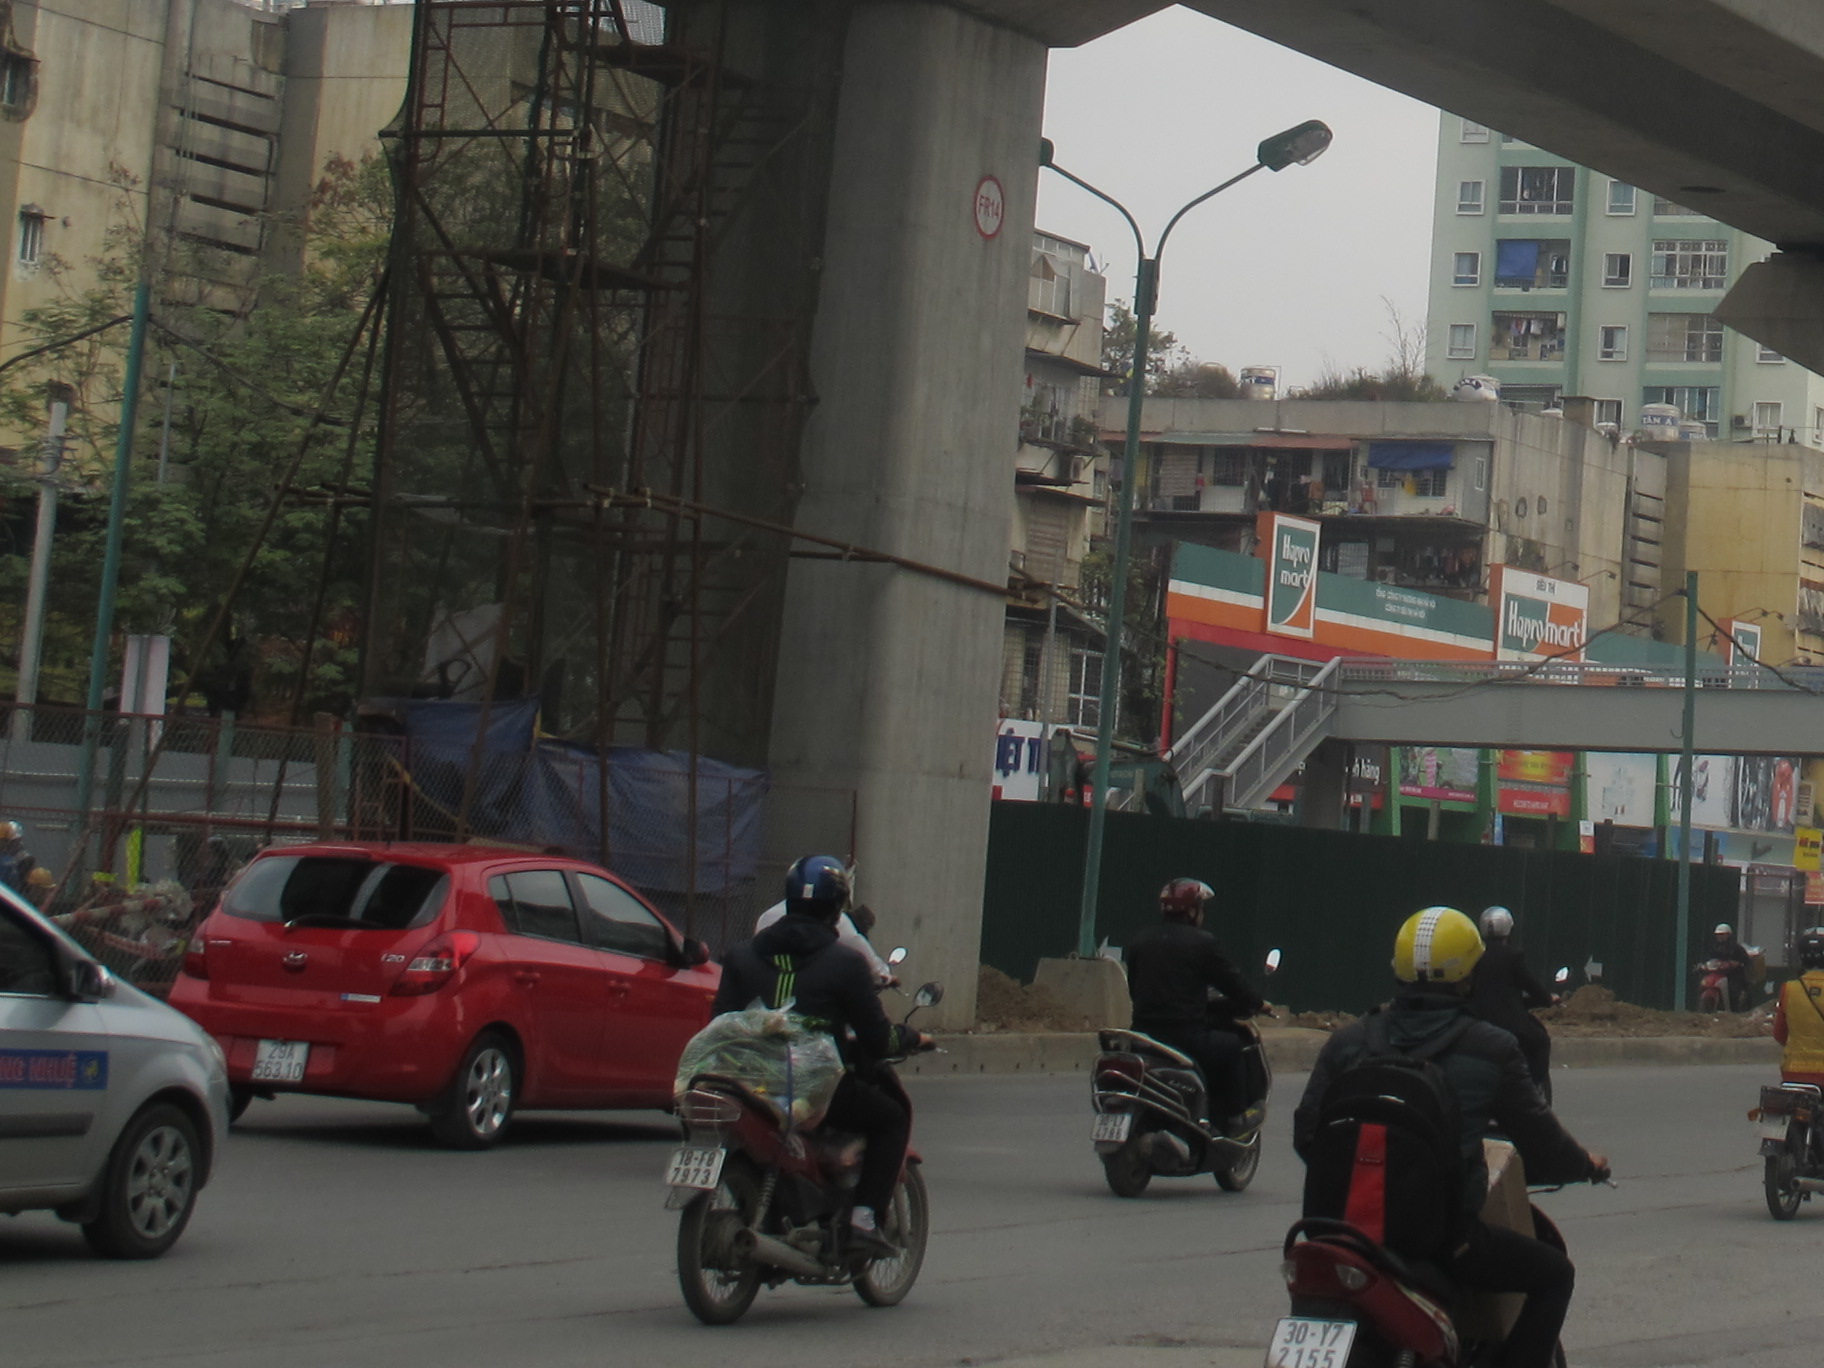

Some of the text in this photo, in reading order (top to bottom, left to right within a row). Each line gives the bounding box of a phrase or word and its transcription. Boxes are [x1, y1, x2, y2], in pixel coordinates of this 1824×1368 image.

[1282, 534, 1311, 568] Hapro
[1280, 569, 1310, 589] mart
[268, 1042, 295, 1060] 29A
[254, 1060, 303, 1080] 563.10
[1283, 1321, 1345, 1347] 30-Y7
[1277, 1346, 1337, 1368] 2155
